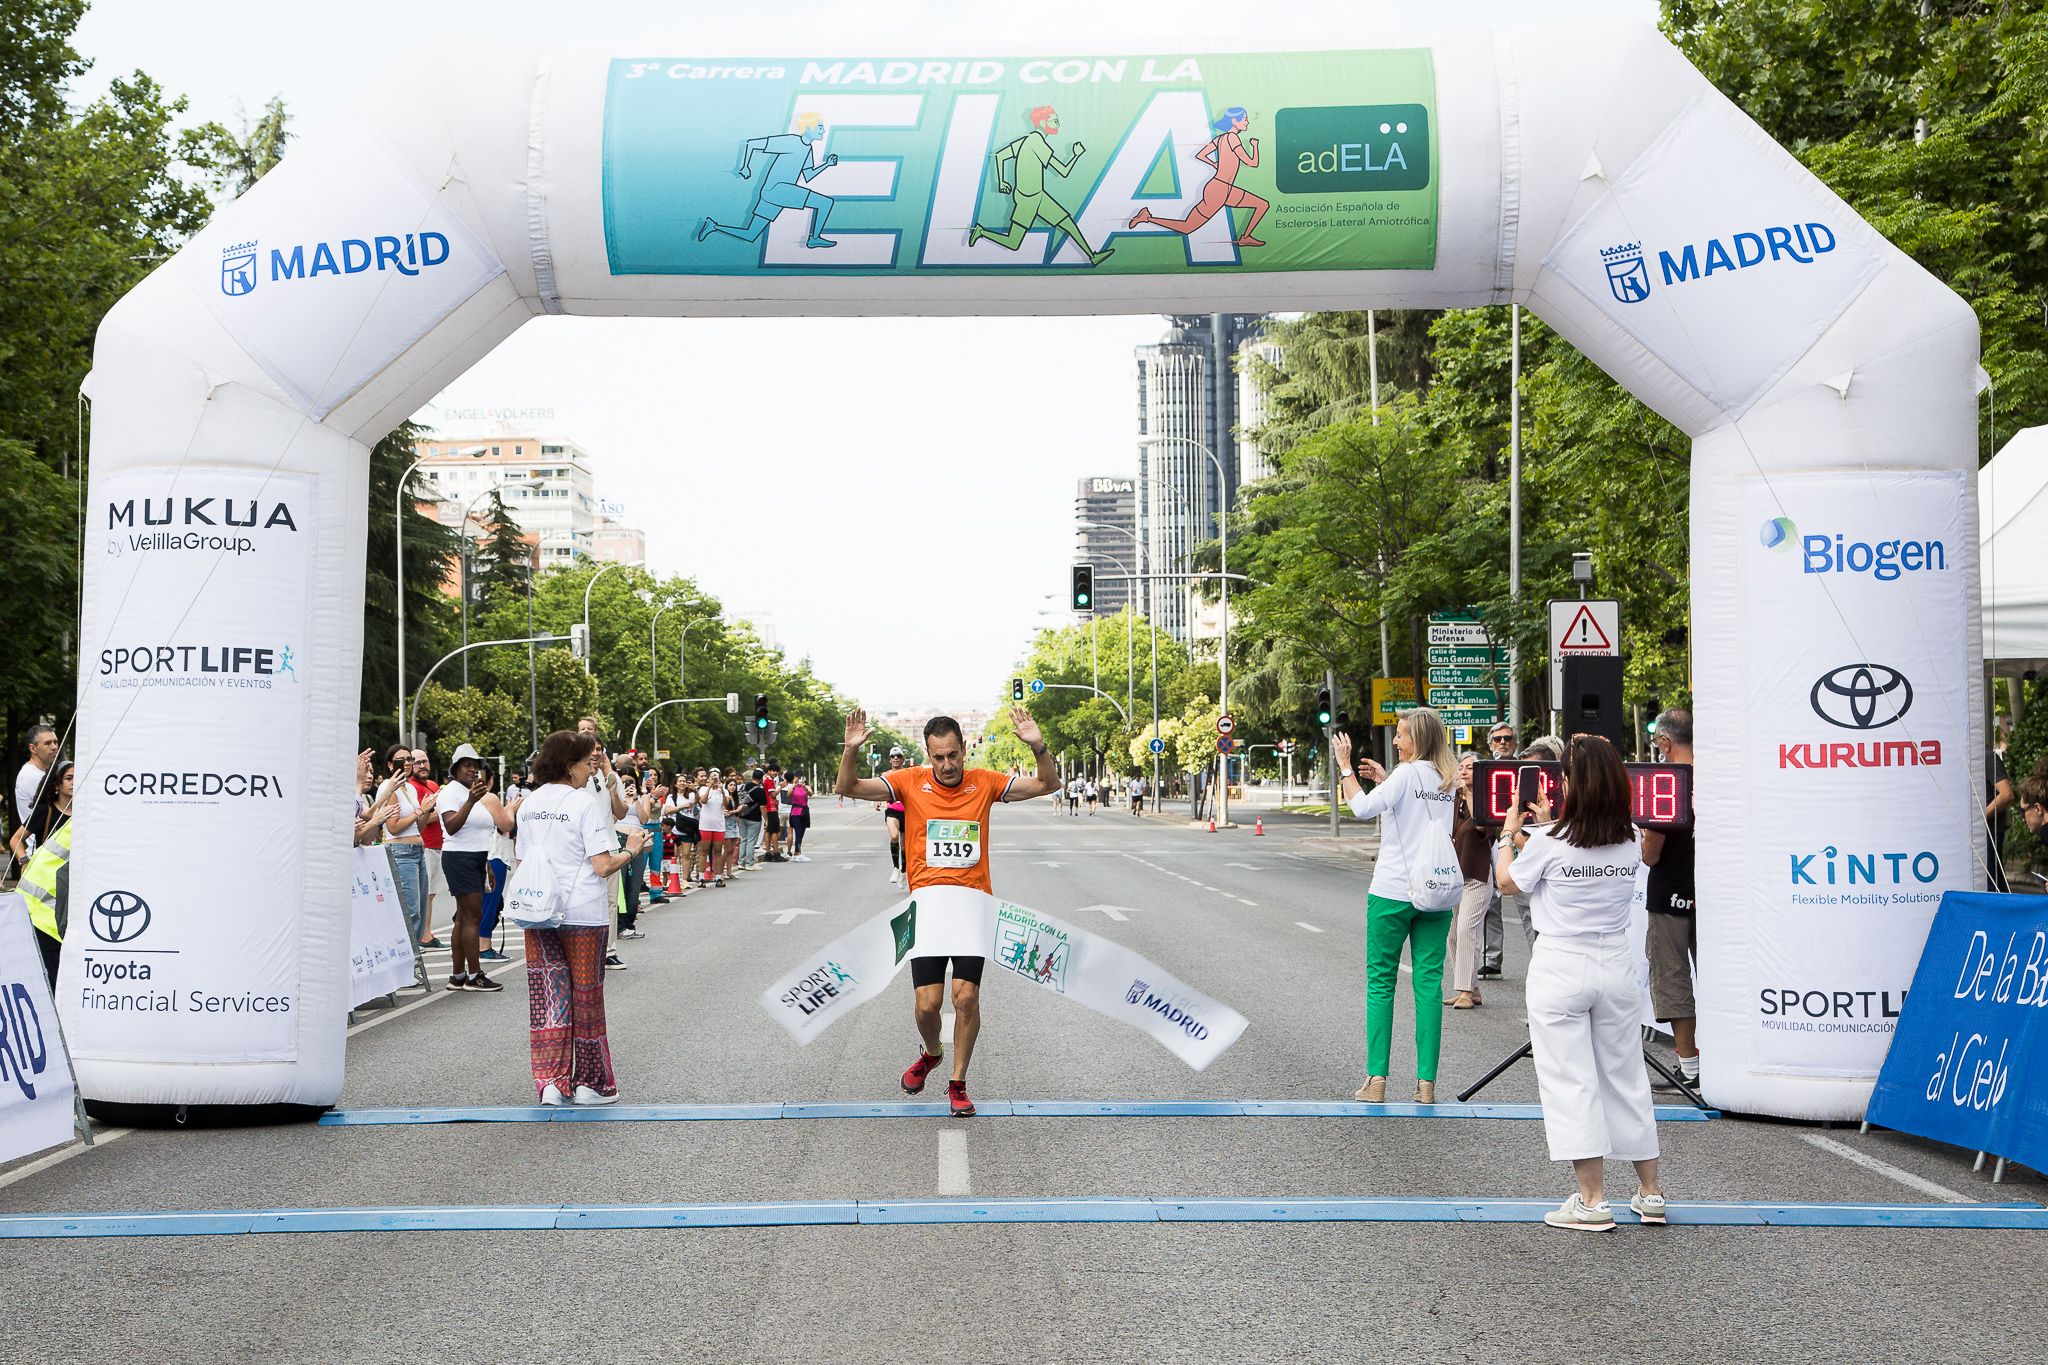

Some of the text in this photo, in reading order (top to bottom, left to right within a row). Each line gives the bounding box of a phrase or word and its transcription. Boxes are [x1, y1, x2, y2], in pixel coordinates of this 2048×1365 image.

[667, 63, 787, 80] Carrera
[800, 61, 1005, 86] MADRID
[1018, 60, 1130, 84] CON
[1140, 59, 1205, 83] LA
[758, 87, 1243, 268] ELA
[1275, 200, 1400, 214] Asociación Española de
[1275, 215, 1430, 229] Esclerosis Lateral Amiotrófica
[271, 231, 450, 281] MADRID
[1658, 222, 1836, 286] MADRID
[1093, 478, 1132, 493] BBVA
[108, 497, 298, 531] MUKUA
[107, 532, 256, 558] by VelillaGroup.
[1803, 533, 1945, 582] Biogen
[1431, 654, 1486, 663] San Germán
[142, 676, 218, 688] COMUNICACIÓN
[219, 678, 226, 687] Y
[227, 678, 273, 689] EVENTOS
[938, 825, 969, 838] ELA
[933, 842, 973, 858] 1319
[1009, 904, 1036, 918] Carrera
[1670, 893, 1694, 910] for
[1792, 892, 1941, 907] Flexible Mobility Solutions
[999, 909, 1068, 942] MADRID CON LA
[993, 918, 1071, 994] ELA
[1954, 930, 1995, 1001] De
[1992, 931, 2019, 1004] la
[84, 957, 152, 985] Toyota
[781, 965, 830, 1008] SPORT
[799, 982, 840, 1015] LIFE
[82, 988, 291, 1014] Financial Services
[1143, 993, 1209, 1041] MADRID
[1761, 1020, 1816, 1033] MOVILIDAD,
[1926, 1032, 1960, 1102] al
